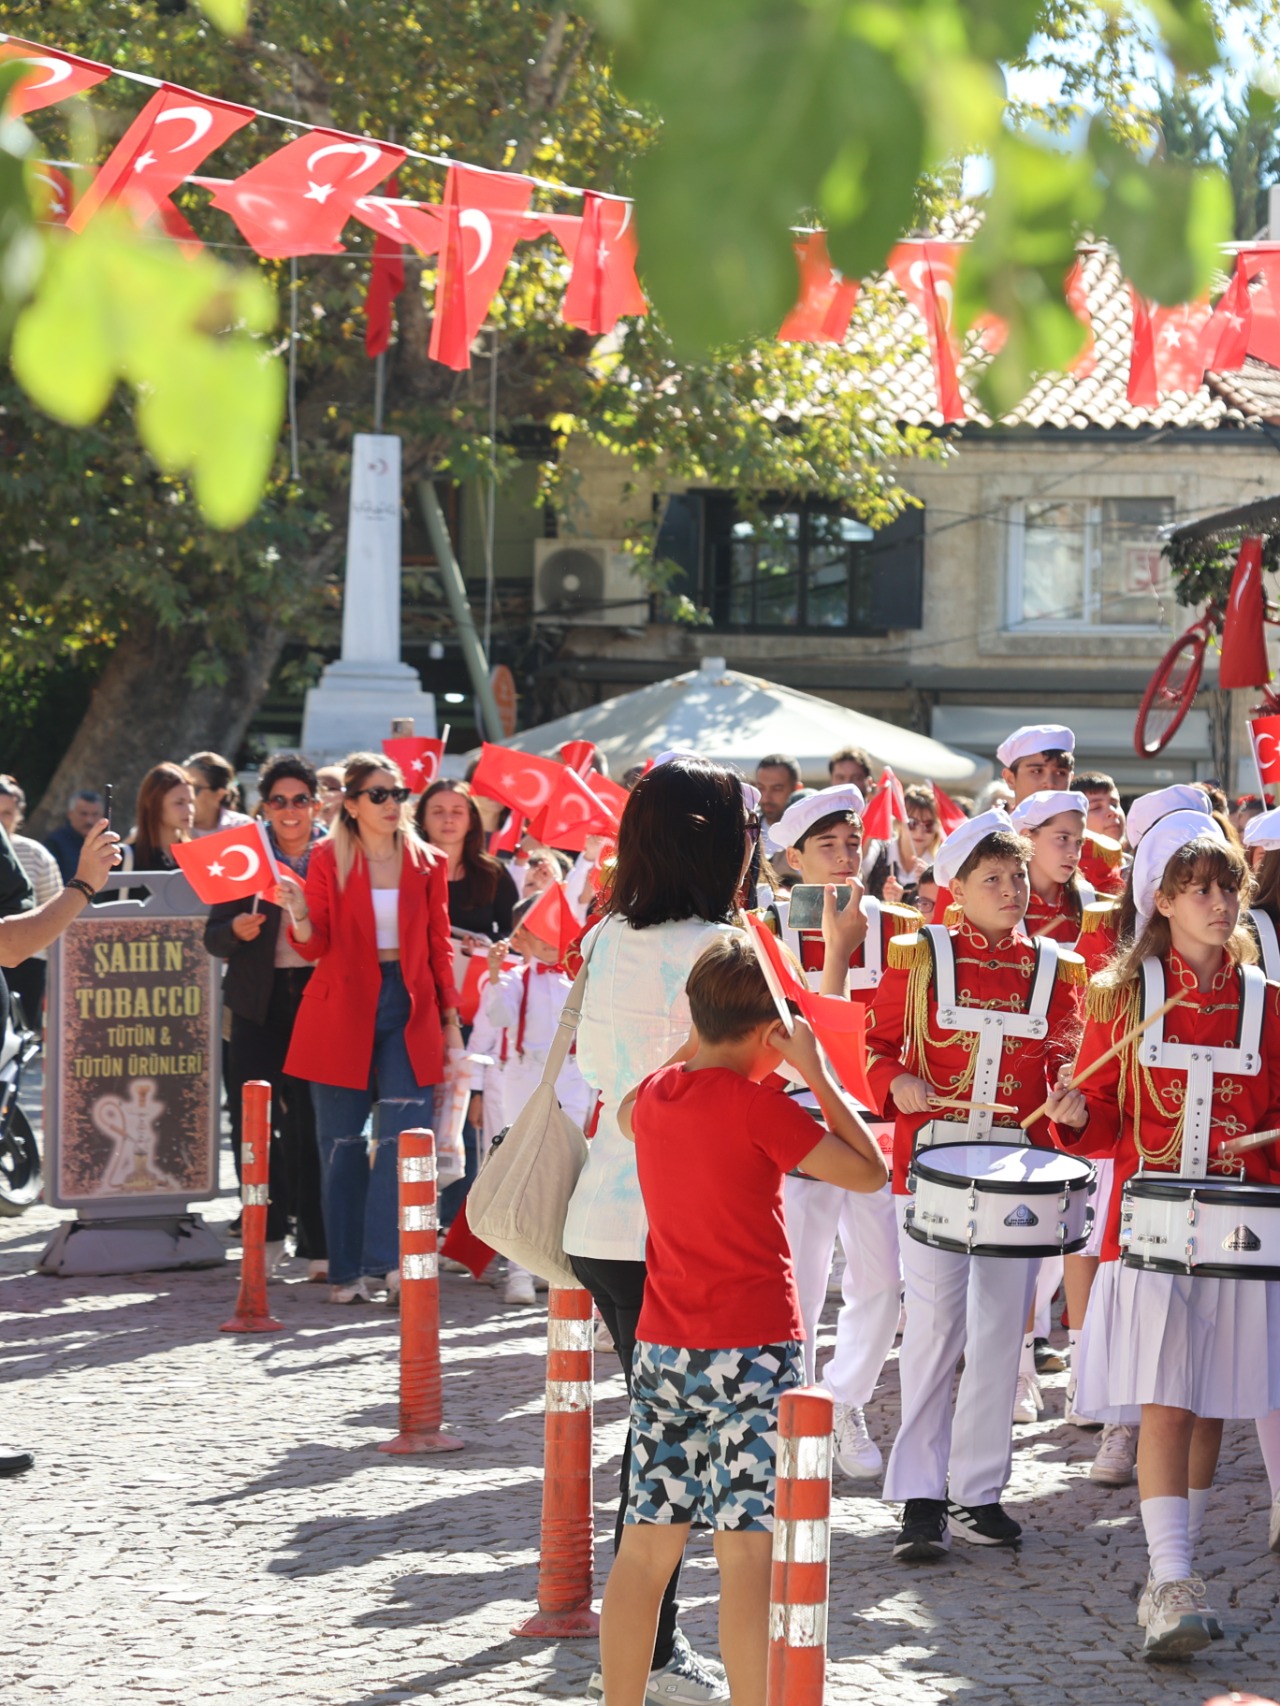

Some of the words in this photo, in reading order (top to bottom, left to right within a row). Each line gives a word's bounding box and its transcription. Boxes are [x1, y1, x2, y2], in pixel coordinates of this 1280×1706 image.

[93, 934, 184, 979] ŞAHİN
[75, 985, 202, 1020] TOBACCO
[107, 1025, 156, 1048] TÜTÜN
[160, 1025, 172, 1046] &
[74, 1056, 123, 1078] TÜTÜN
[128, 1051, 203, 1077] ÜRÜNLERİ
